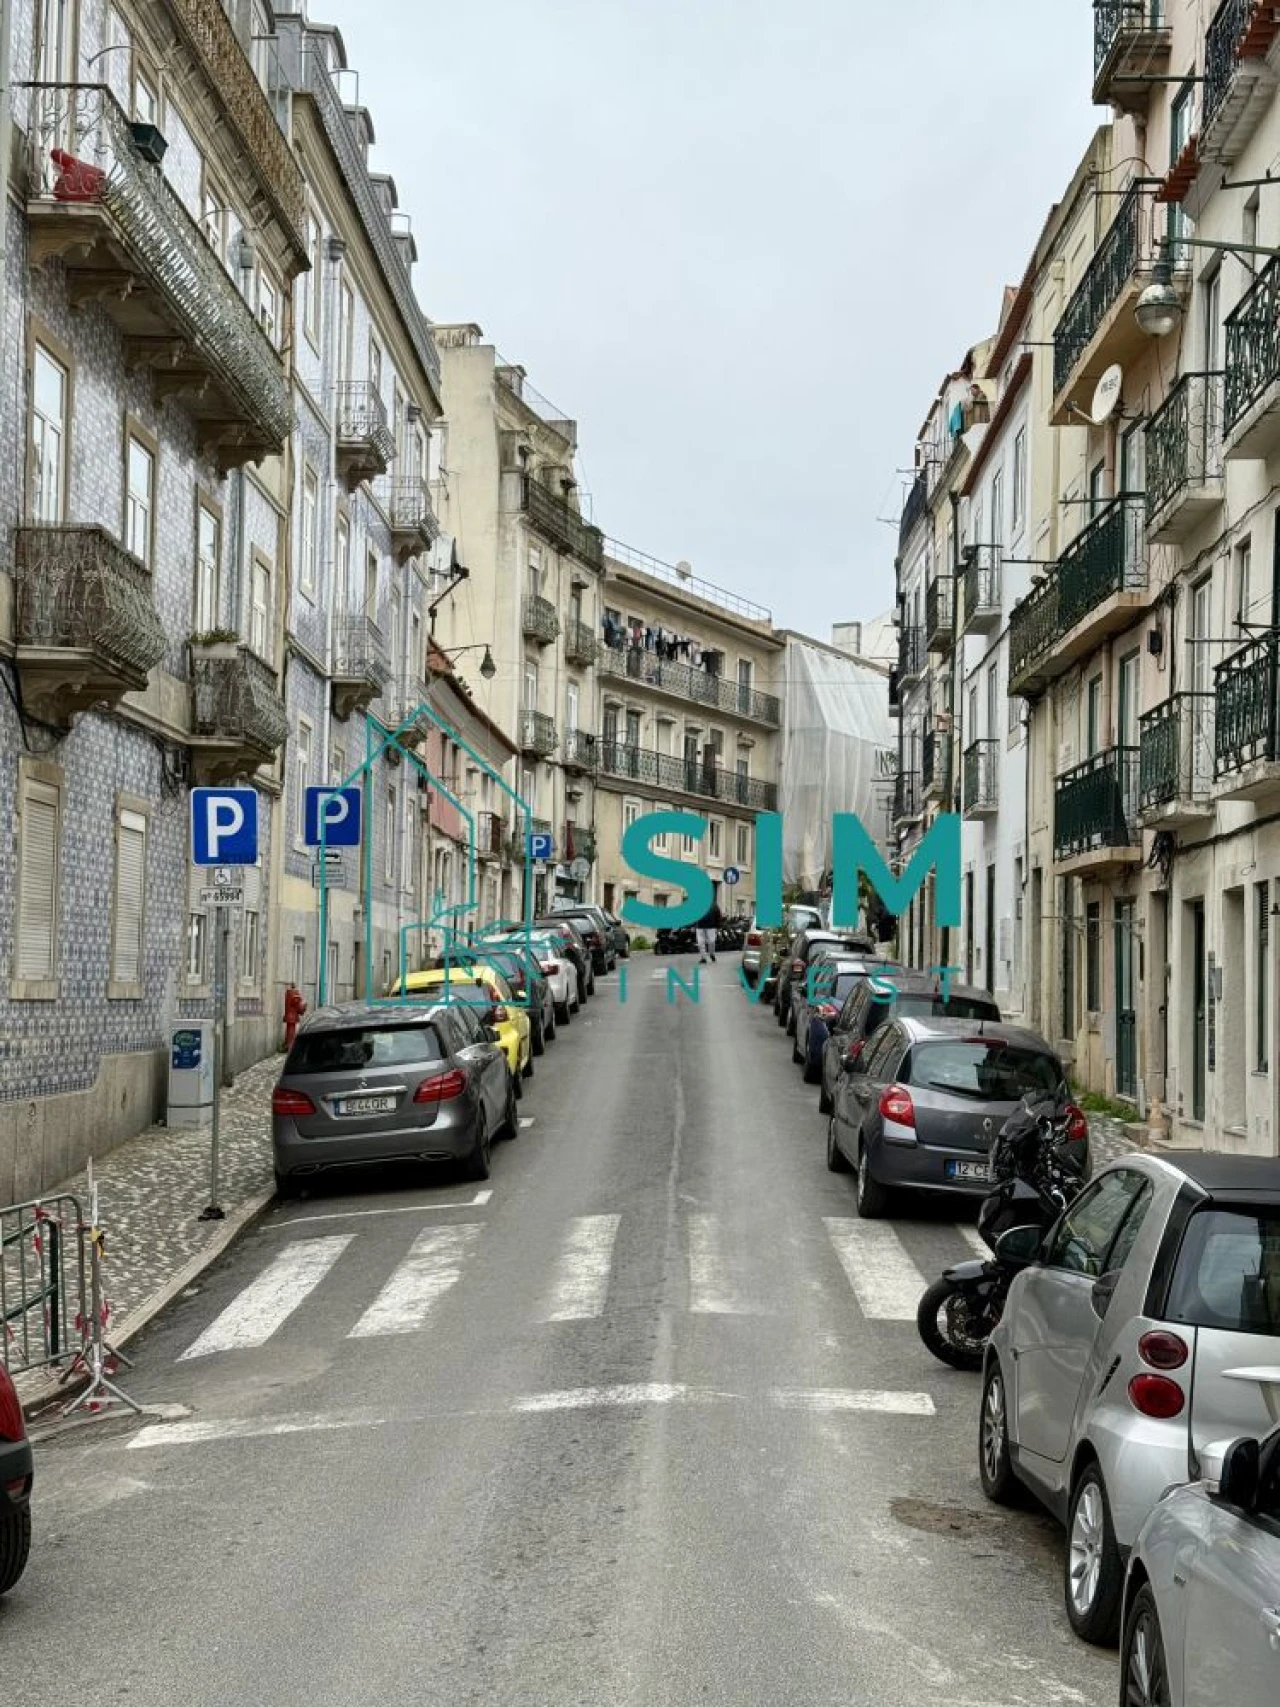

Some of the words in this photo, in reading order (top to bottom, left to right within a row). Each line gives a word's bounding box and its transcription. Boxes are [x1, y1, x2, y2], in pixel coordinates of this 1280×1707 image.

[207, 796, 245, 858] P
[317, 793, 349, 841] P
[531, 836, 547, 856] P
